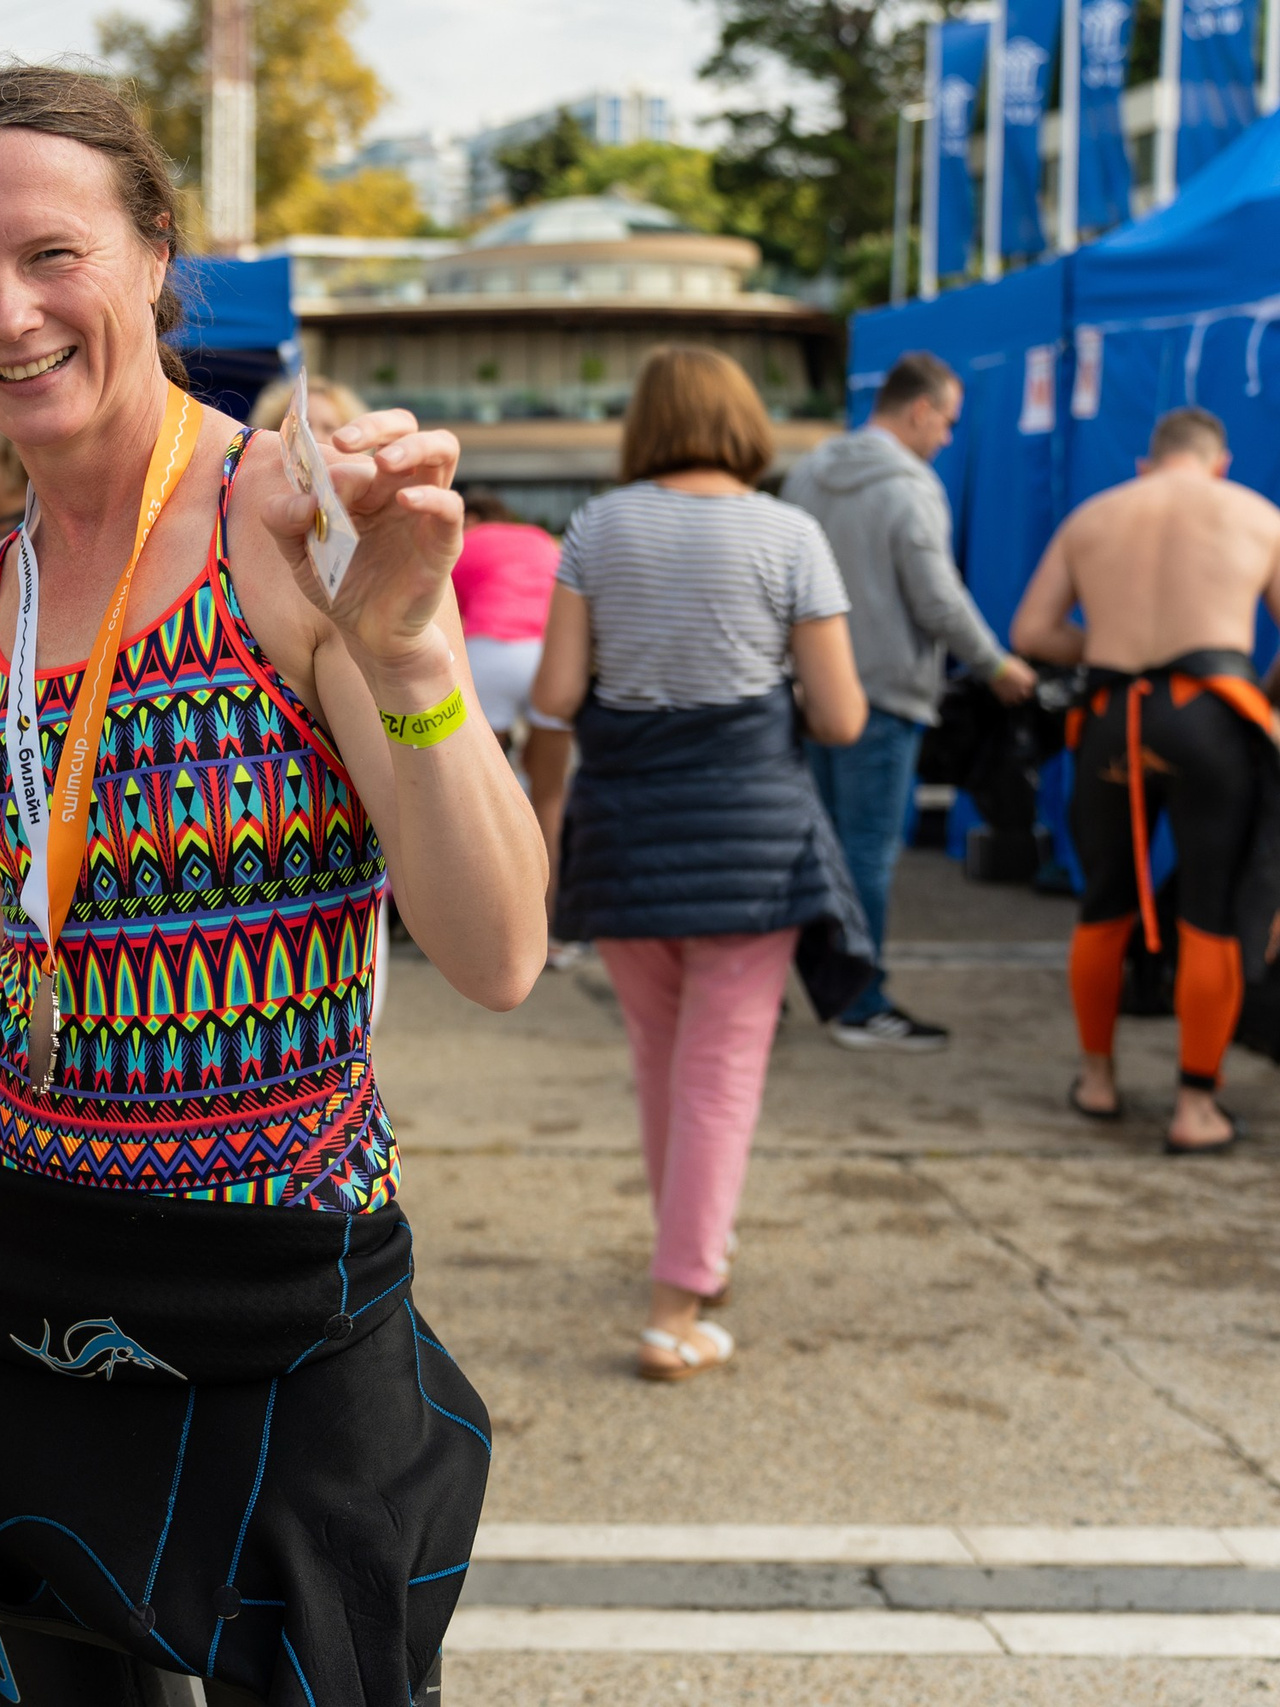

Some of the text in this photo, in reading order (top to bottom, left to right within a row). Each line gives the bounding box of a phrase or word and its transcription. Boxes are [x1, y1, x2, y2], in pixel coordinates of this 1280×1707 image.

[61, 737, 90, 823] swimcup
[108, 584, 128, 631] сочи
[411, 690, 464, 734] imcup
[18, 747, 41, 825] билайн
